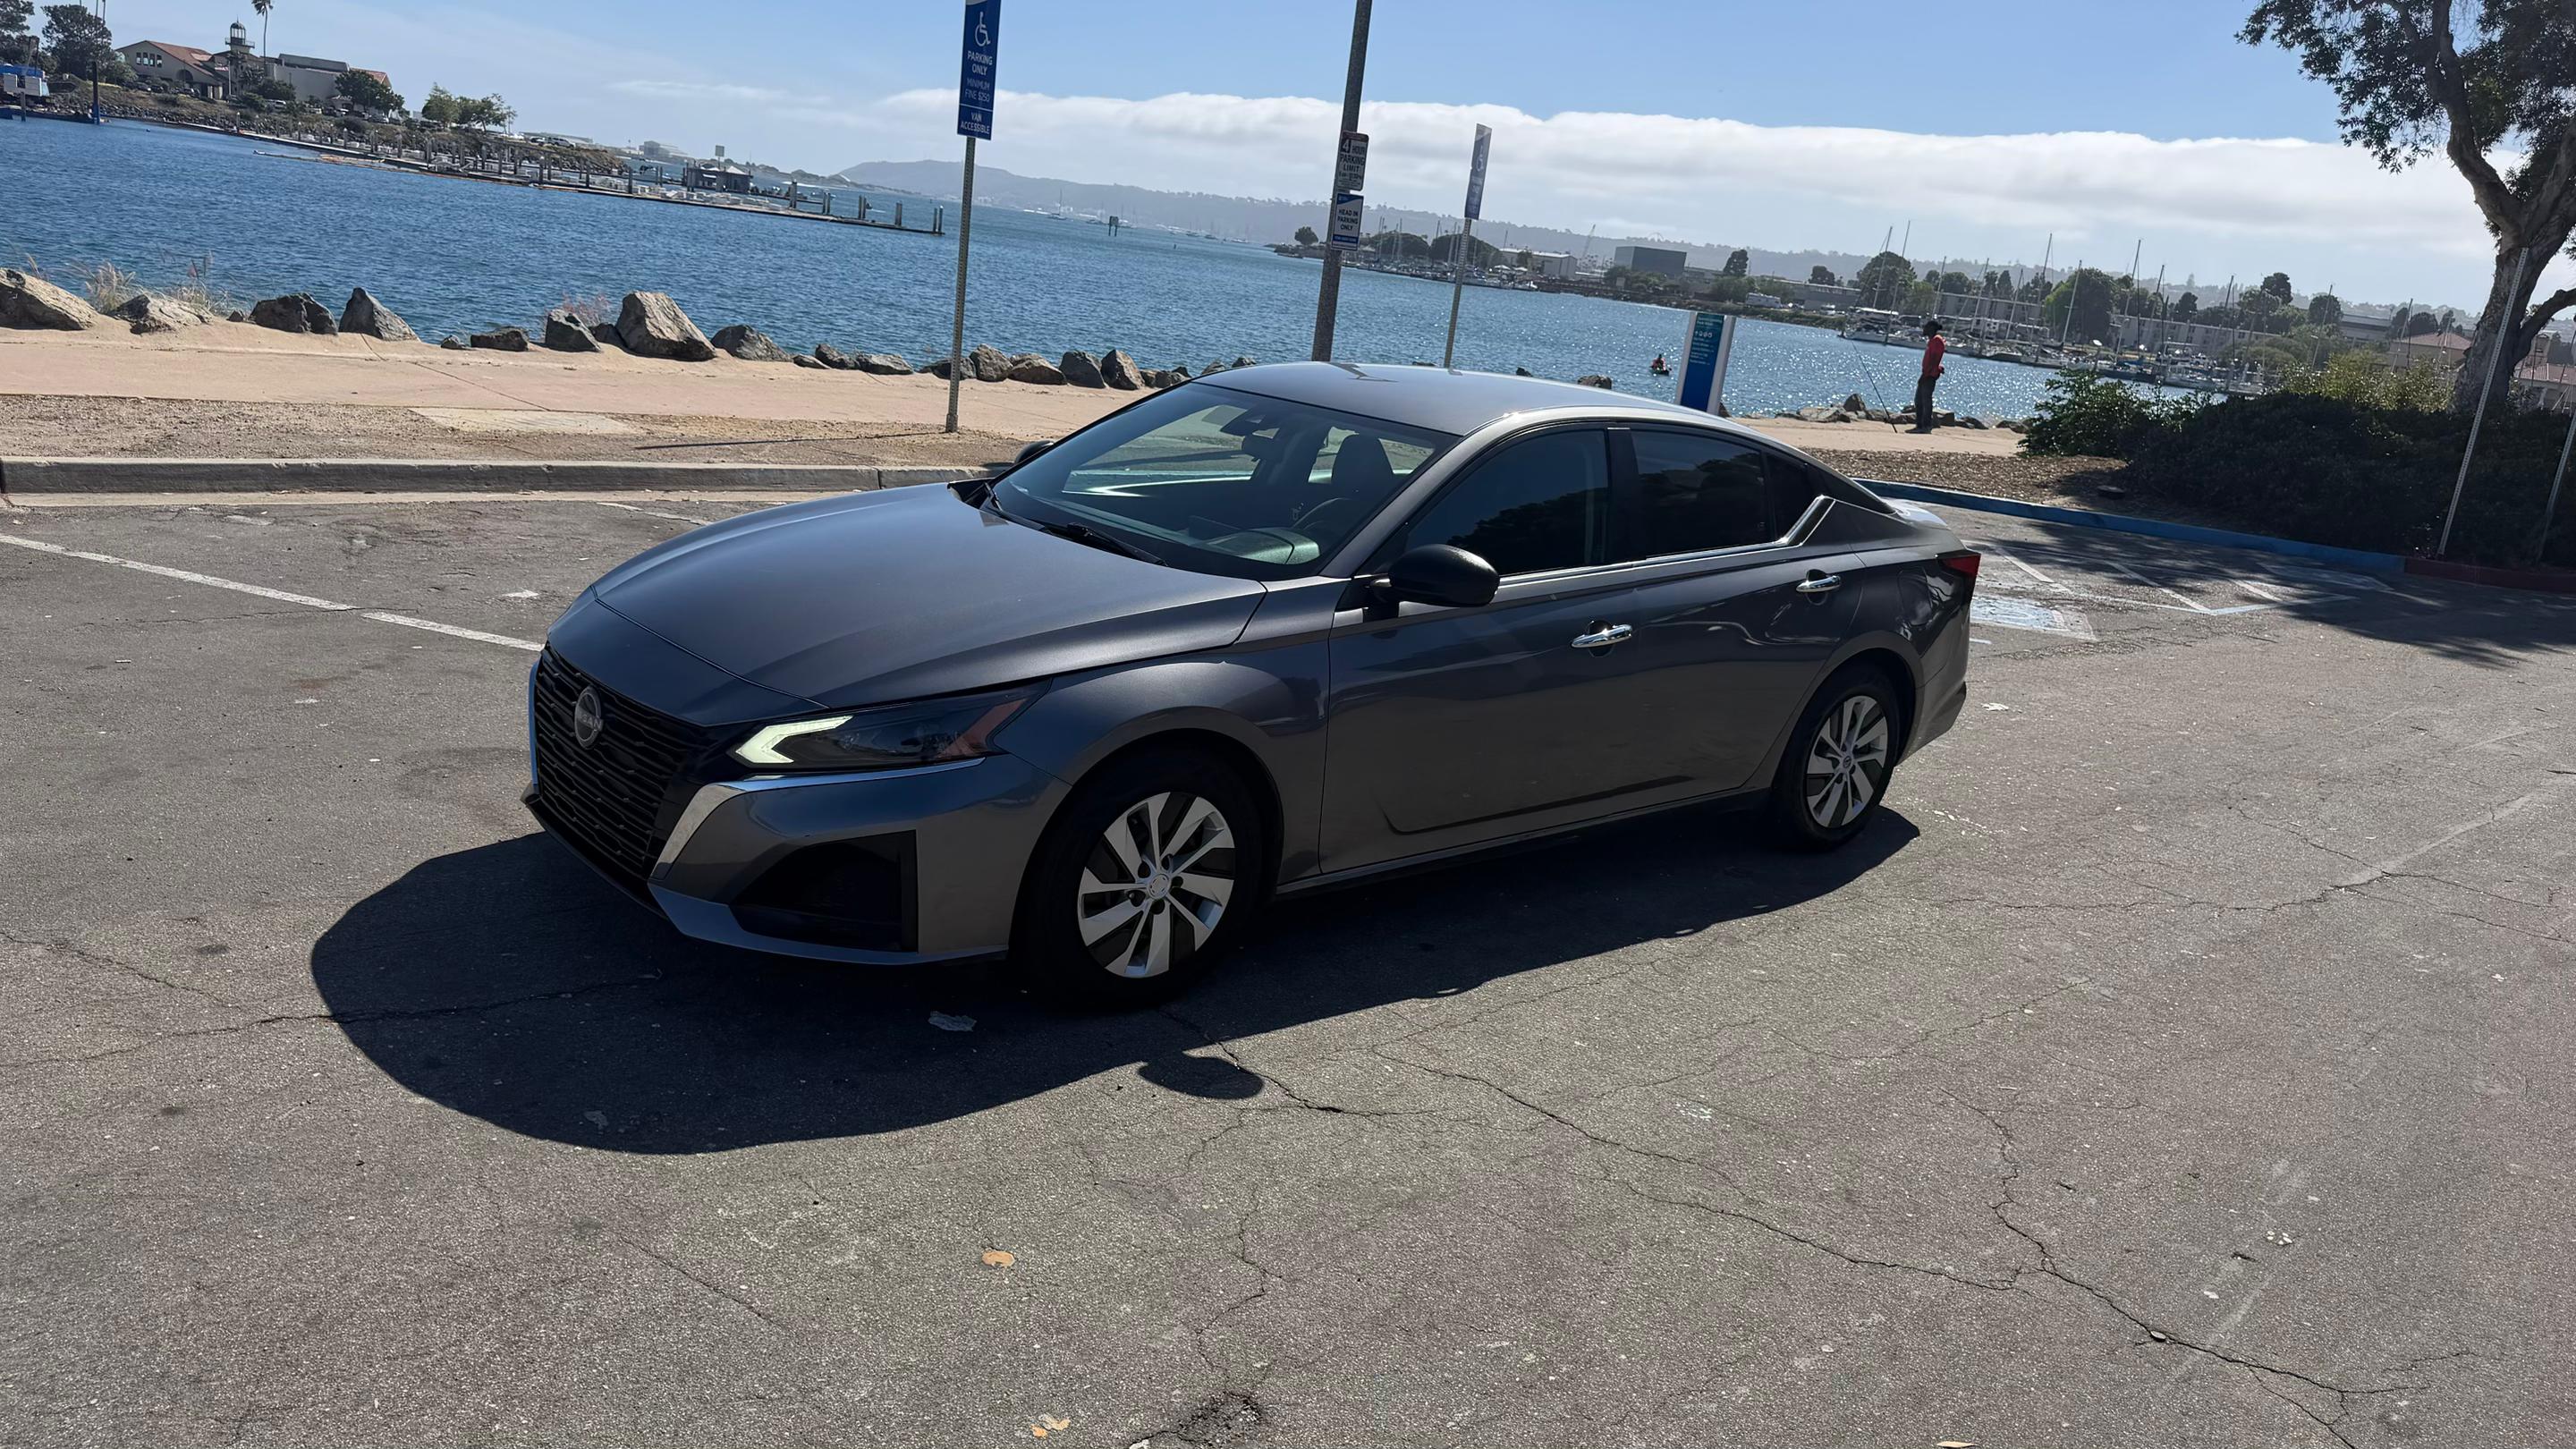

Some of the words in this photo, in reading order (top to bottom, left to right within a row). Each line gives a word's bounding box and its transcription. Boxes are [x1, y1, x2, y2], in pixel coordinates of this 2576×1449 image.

[968, 51, 993, 65] PARKING
[972, 64, 987, 76] ONLY
[967, 78, 990, 92] MINIMUM
[965, 89, 977, 100] FINE
[978, 91, 990, 103] $250
[971, 112, 982, 123] VAN
[960, 121, 990, 135] ACCESSIBLE
[1342, 139, 1350, 152] 4
[1340, 154, 1365, 165] PARKING
[1343, 164, 1360, 174] LIMIT
[1339, 208, 1352, 216] HEAD
[1337, 216, 1359, 225] PARKING
